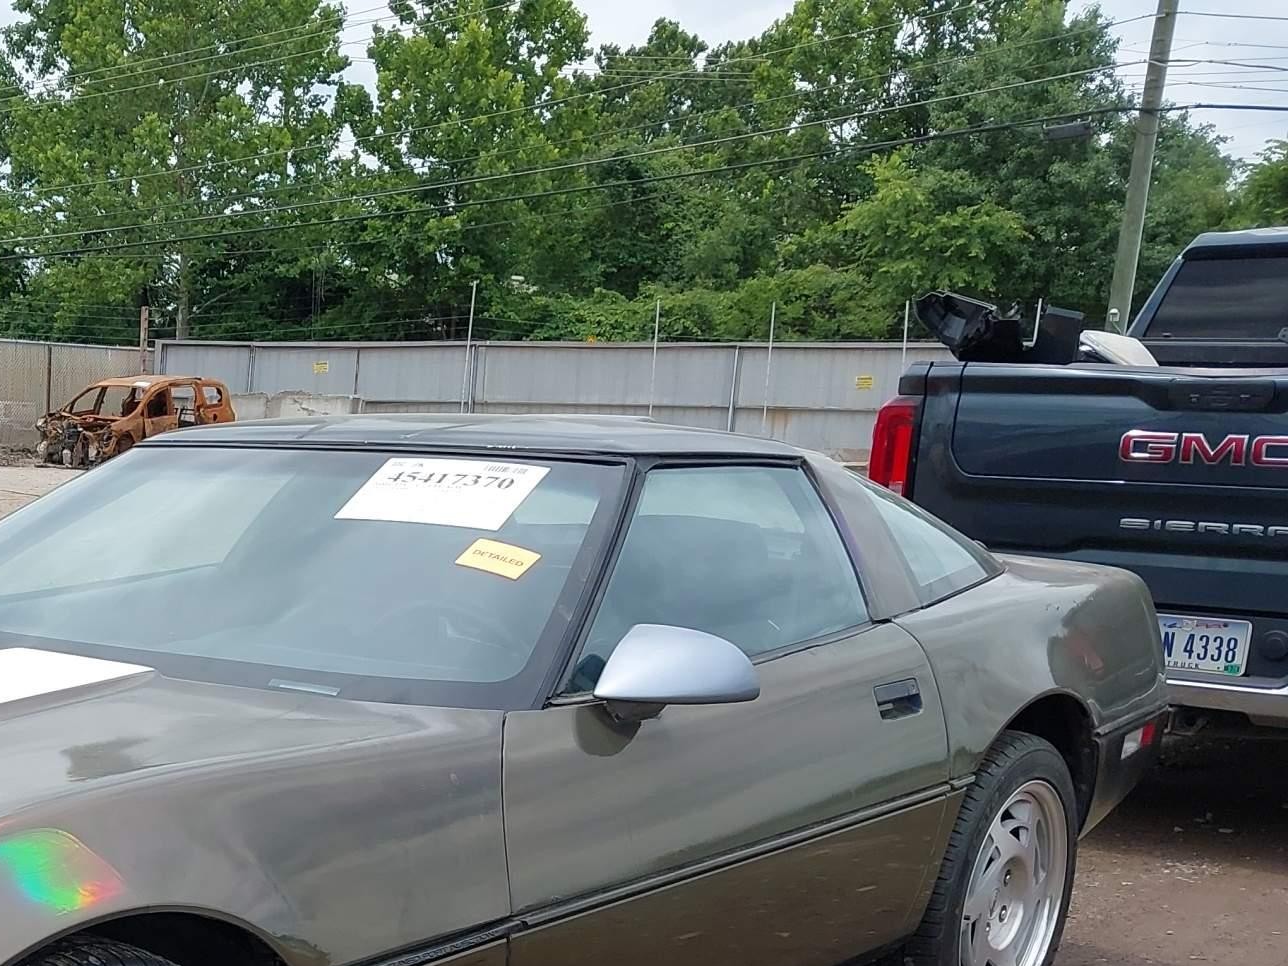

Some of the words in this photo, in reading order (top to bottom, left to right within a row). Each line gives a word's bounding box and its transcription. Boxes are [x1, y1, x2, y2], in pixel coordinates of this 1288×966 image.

[1119, 429, 1288, 468] GMC
[387, 471, 515, 490] 45417370
[472, 549, 524, 567] DETAILED
[1183, 633, 1238, 663] 4338
[1166, 660, 1200, 670] TRUCK
